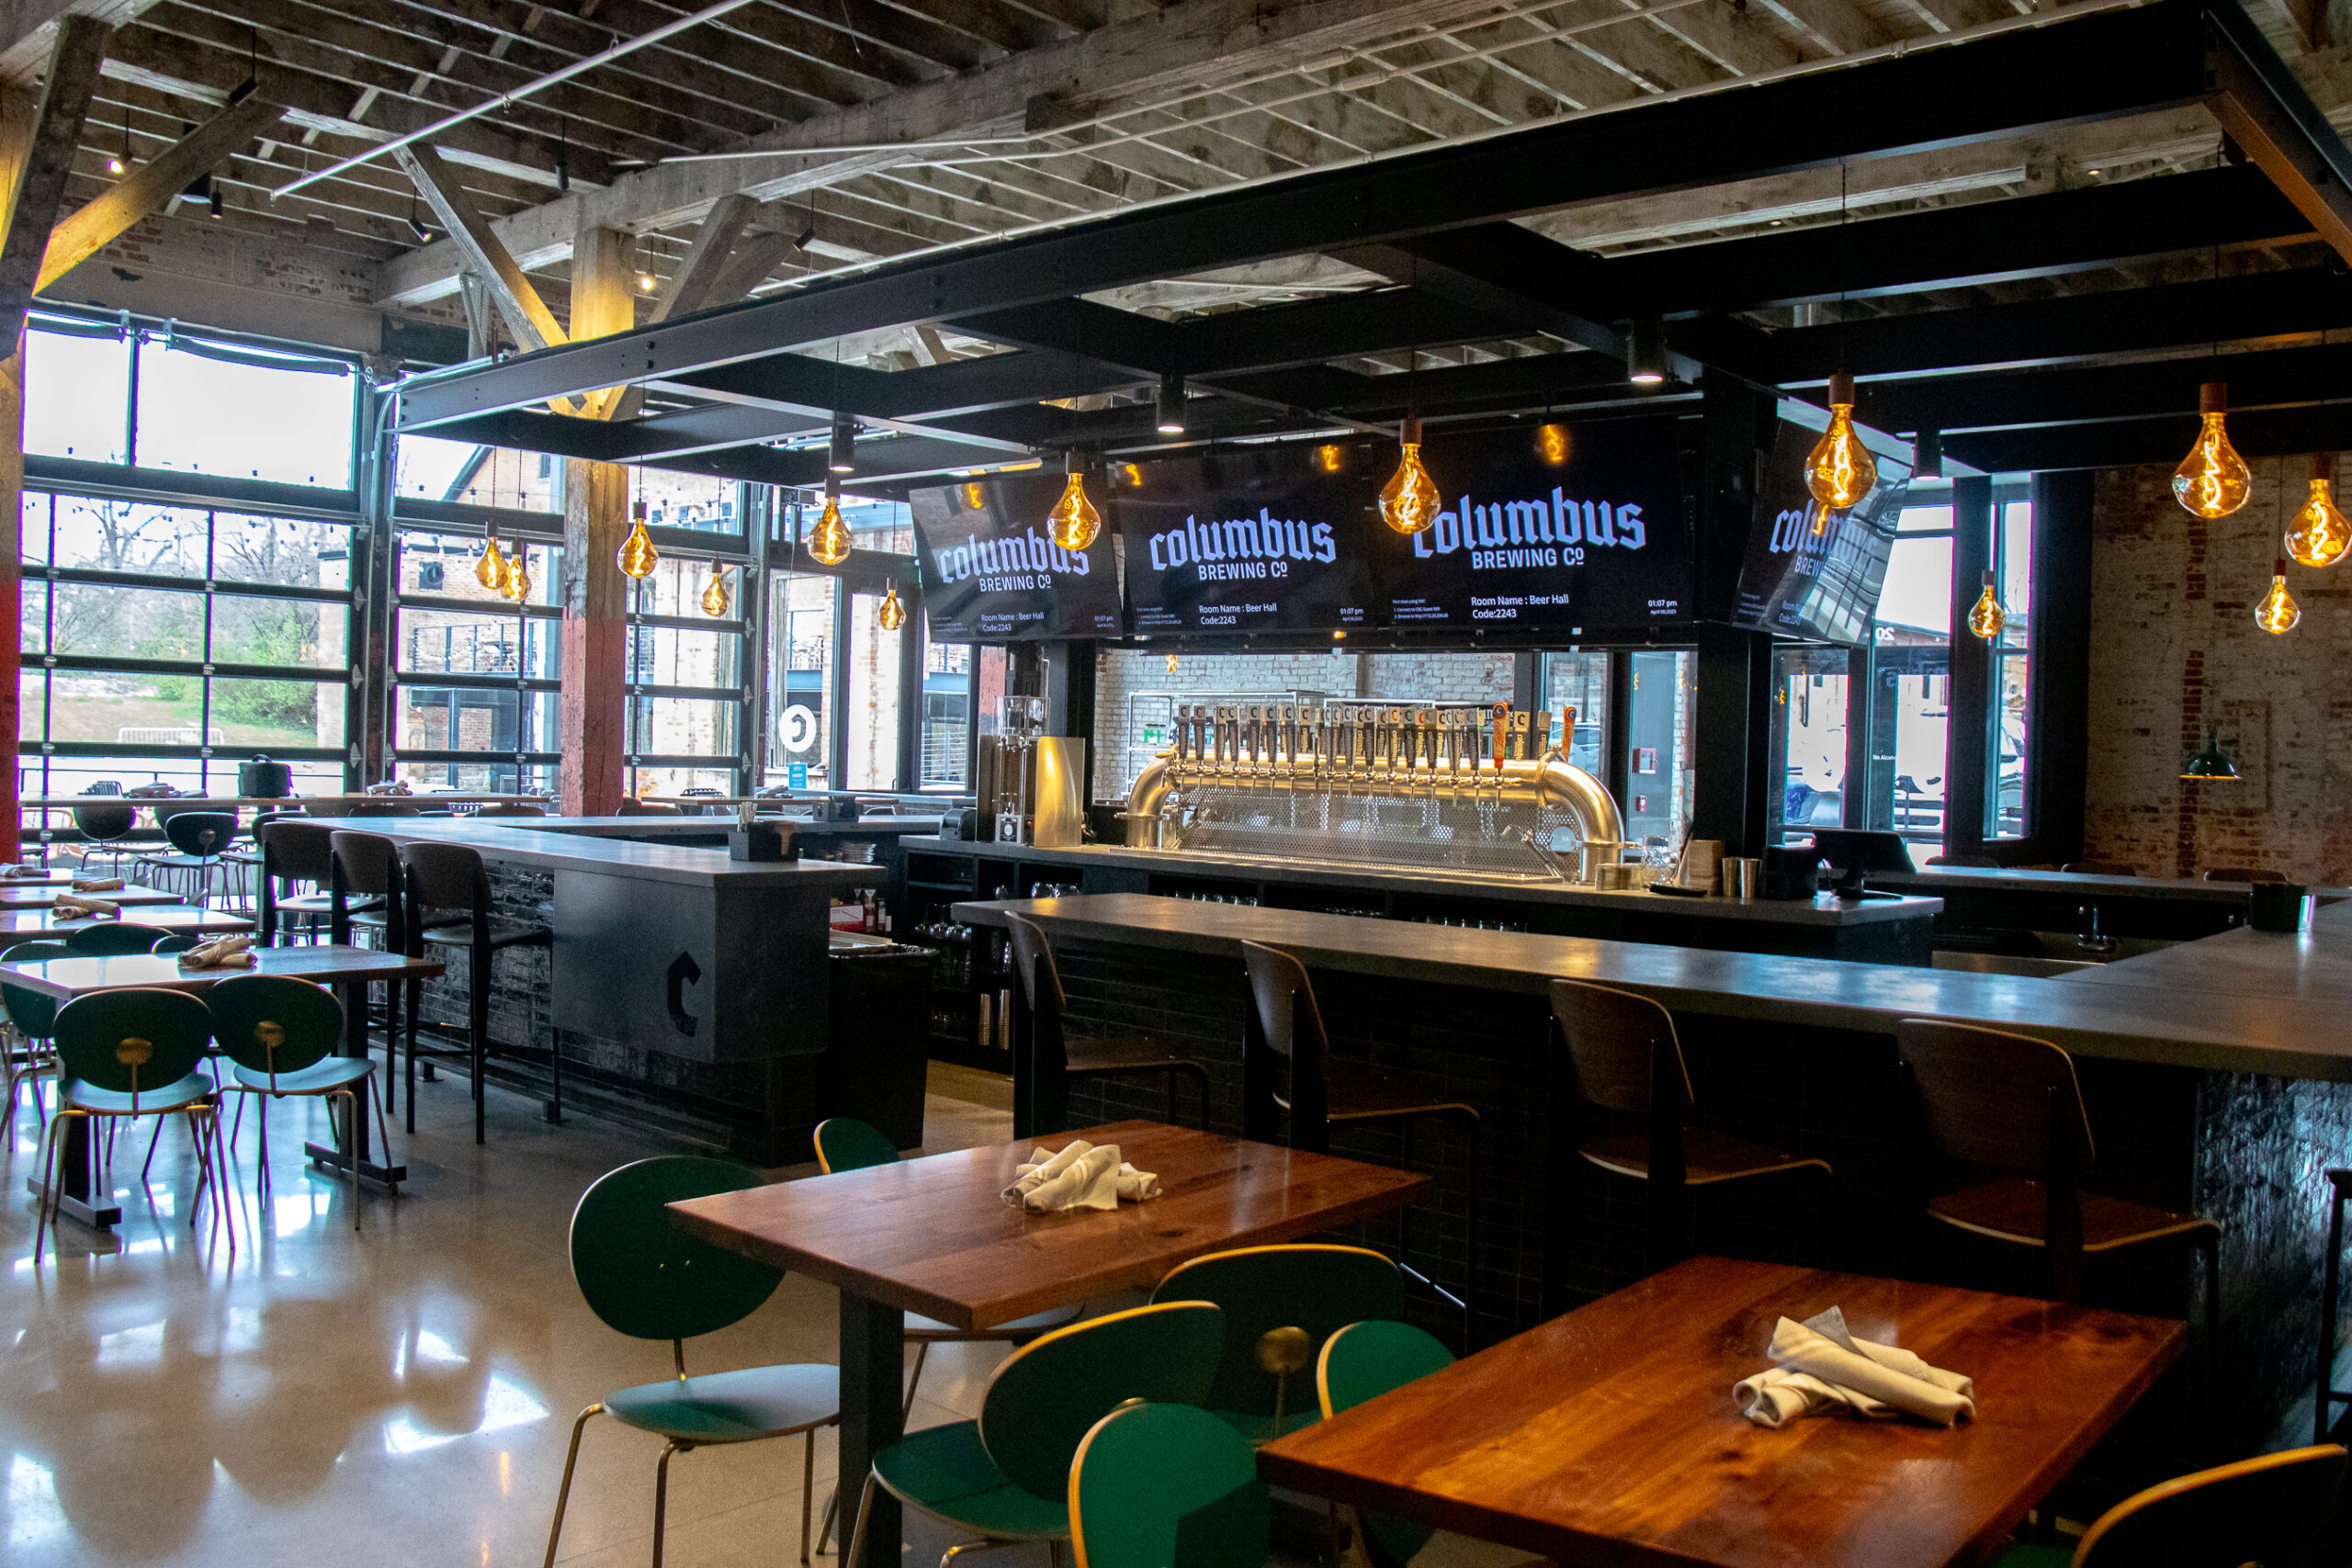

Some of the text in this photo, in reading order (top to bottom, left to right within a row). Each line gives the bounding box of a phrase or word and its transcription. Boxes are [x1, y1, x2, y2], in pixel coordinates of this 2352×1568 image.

[1149, 507, 1337, 570] columbus
[939, 525, 1090, 583] columbus
[1472, 548, 1557, 570] BREWING
[1198, 562, 1266, 581] BREWING
[979, 575, 1035, 592] BREWING
[1471, 596, 1497, 606] Room
[1498, 595, 1523, 605] Name
[1529, 595, 1550, 604] Beer
[1552, 594, 1569, 604] Hall
[1199, 604, 1219, 614] Room
[1220, 604, 1240, 613] Name
[1246, 604, 1261, 613] Beer
[1263, 603, 1277, 612] Hall
[1472, 609, 1517, 618] Code:2243
[981, 614, 998, 622] Room
[1033, 611, 1044, 619] Hall
[1200, 616, 1236, 625] Code:2243
[982, 623, 1012, 632] Code:2243
